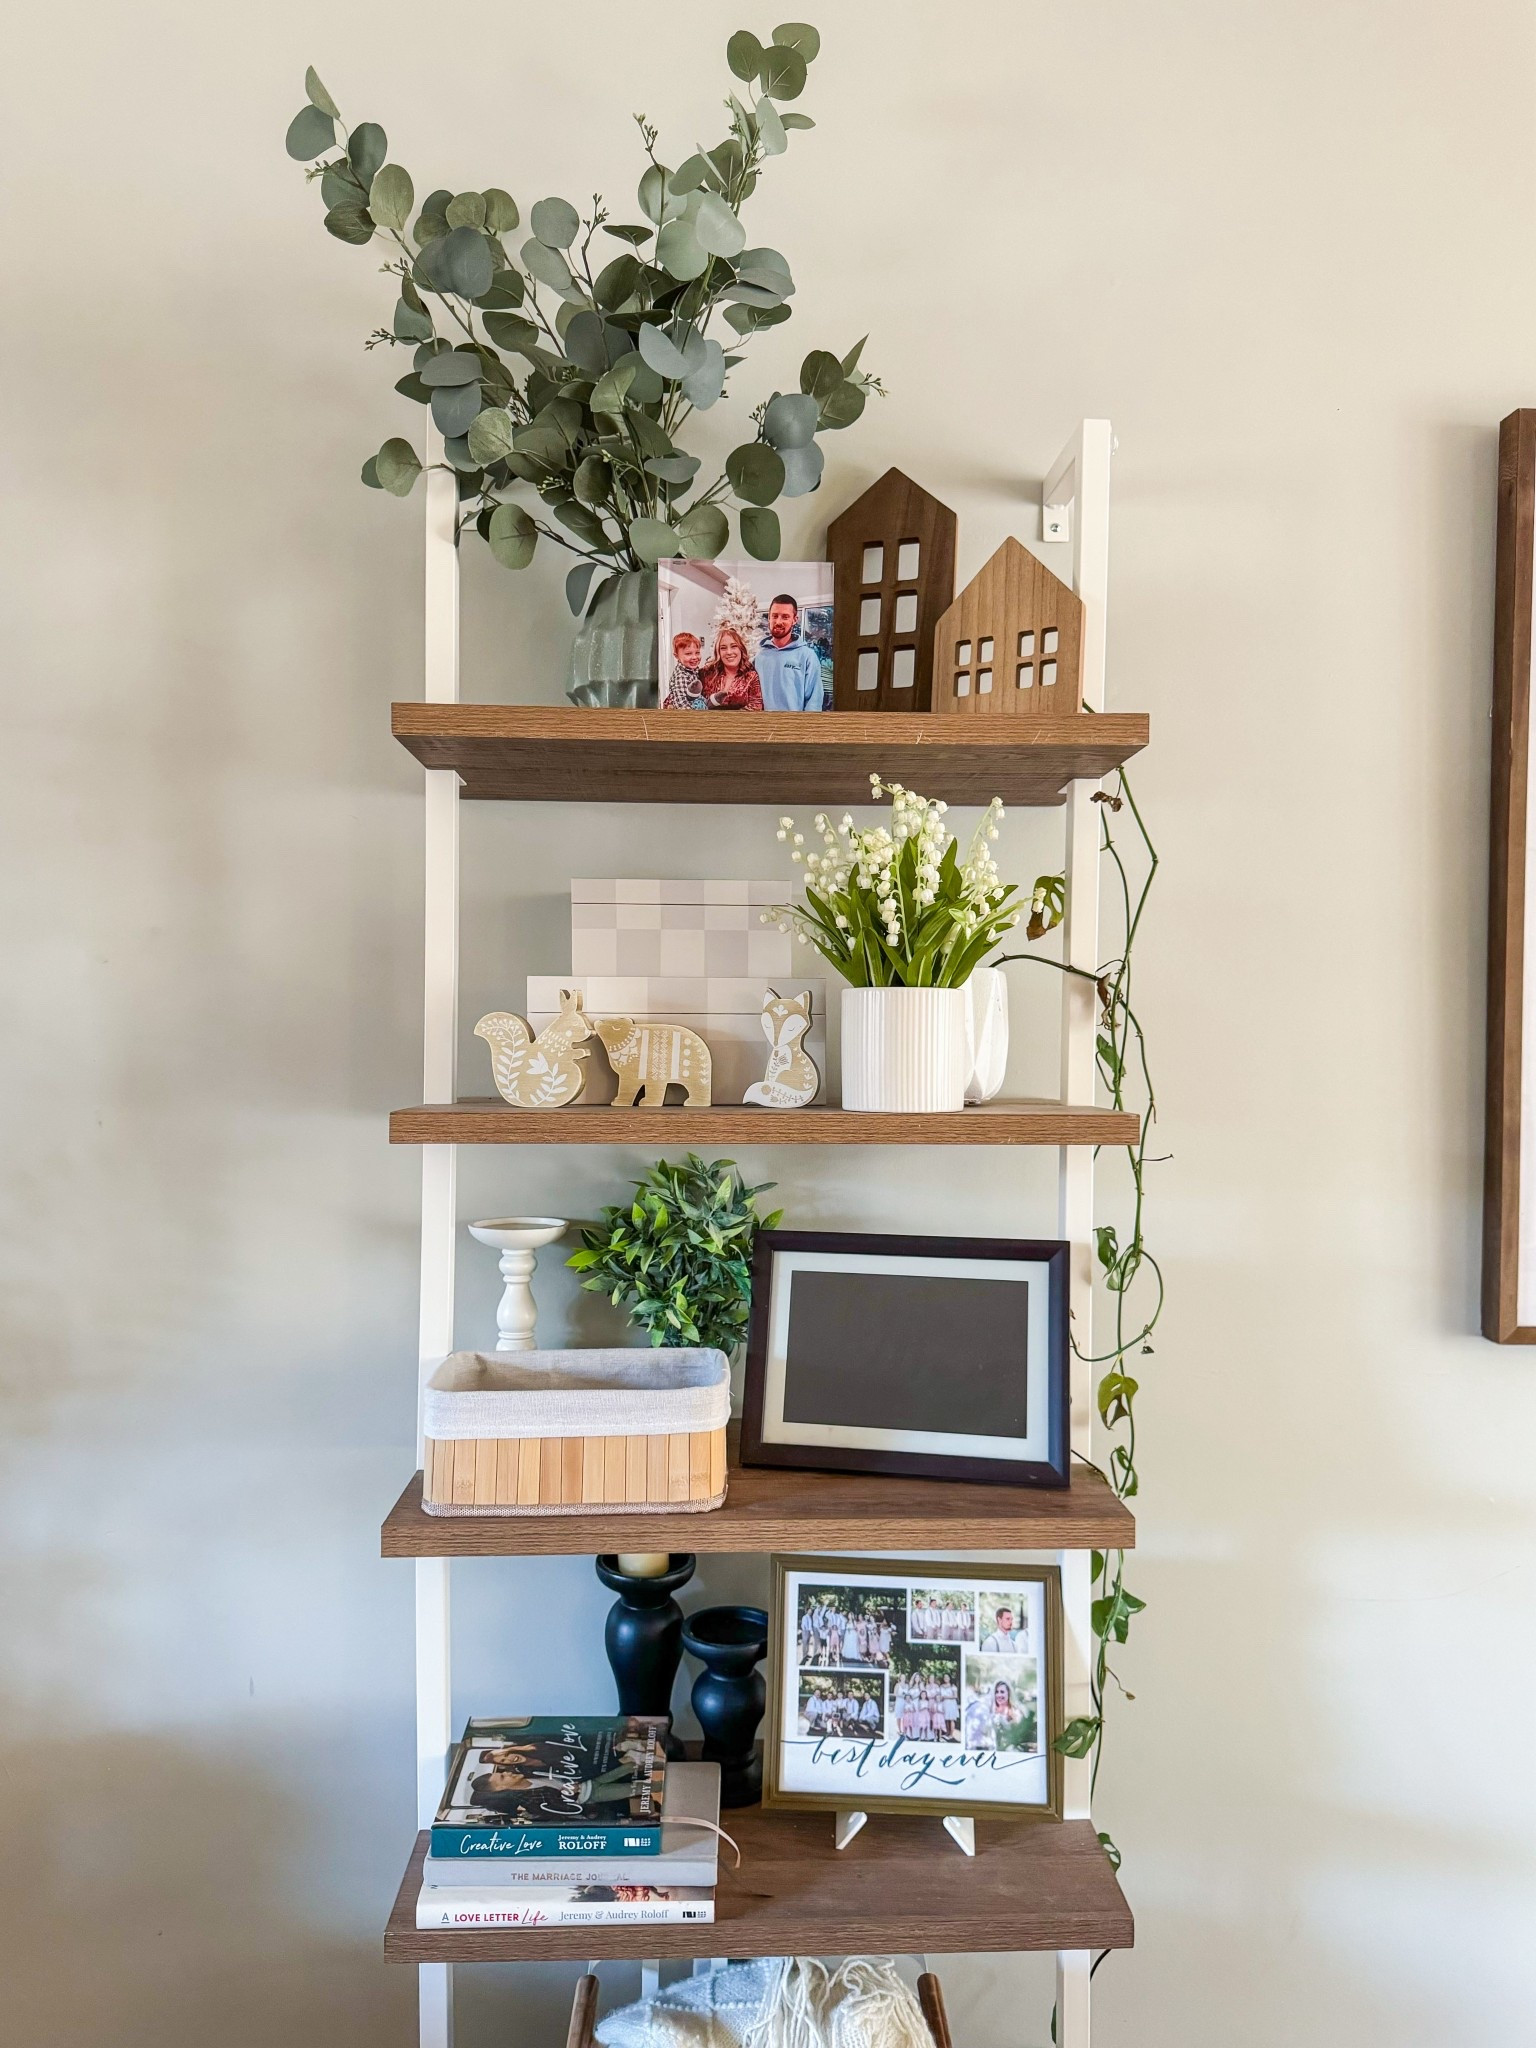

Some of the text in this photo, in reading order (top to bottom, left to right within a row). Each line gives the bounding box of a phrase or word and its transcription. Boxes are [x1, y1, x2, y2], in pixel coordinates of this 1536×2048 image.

[646, 1726, 657, 1750] ROLOFF
[532, 1722, 588, 1815] Creative Love
[643, 1751, 655, 1777] AUDREY
[781, 1734, 1047, 1791] best day ever
[640, 1785, 652, 1814] JEREMY
[460, 1831, 543, 1855] Creative Love
[557, 1834, 579, 1842] Jeremy
[586, 1834, 607, 1842] Audrey
[558, 1841, 607, 1850] ROLOFF
[511, 1872, 529, 1881] THE
[532, 1872, 582, 1881] MARRIAGE
[441, 1912, 450, 1923] A
[454, 1912, 481, 1922] LOVE
[483, 1912, 519, 1922] LETTER
[521, 1907, 549, 1926] Life
[559, 1911, 594, 1922] Jeremy
[595, 1910, 604, 1920] &
[605, 1909, 639, 1921] Audrey
[640, 1908, 669, 1920] Roloff
